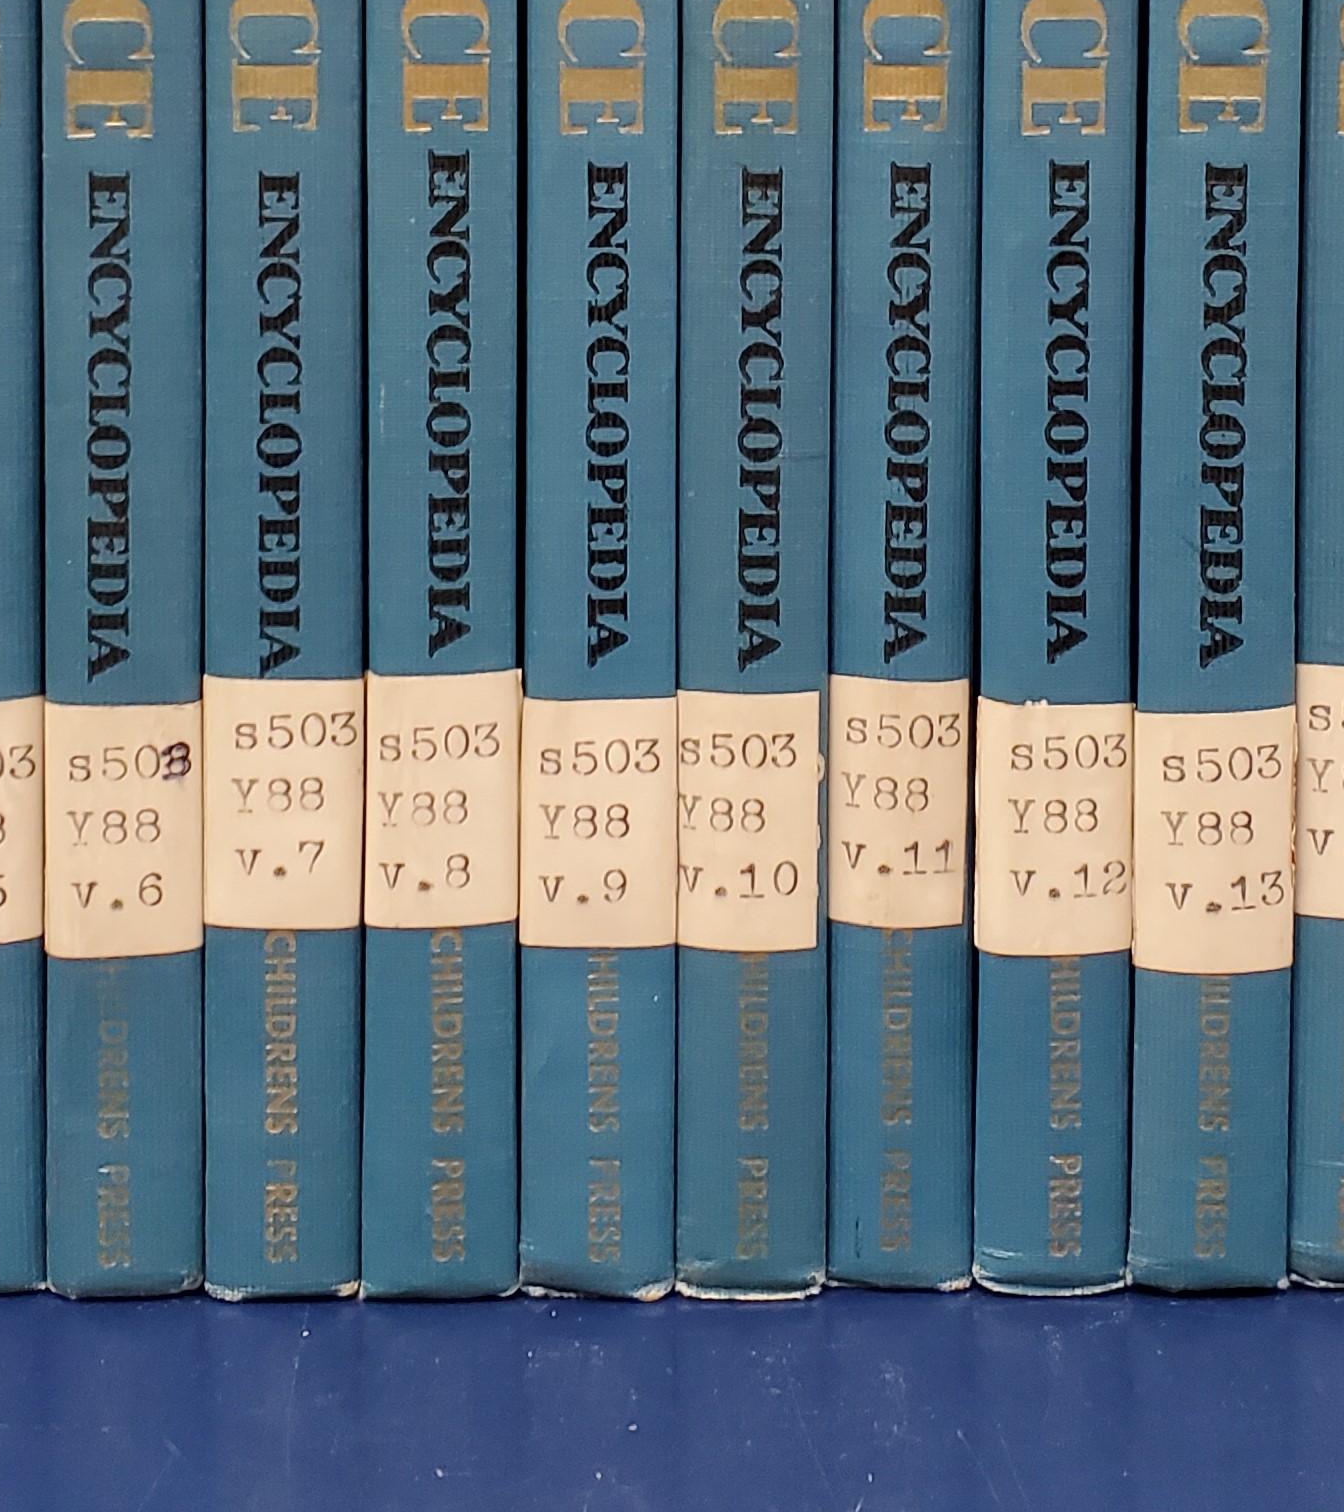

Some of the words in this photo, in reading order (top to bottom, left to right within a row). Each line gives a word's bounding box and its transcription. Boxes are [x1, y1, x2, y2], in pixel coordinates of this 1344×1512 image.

[425, 149, 472, 659] ENCYCLOPEDIA
[737, 166, 785, 673] ENCYCLOPEDIA
[1044, 159, 1091, 665] ENCYCLOPEDIA
[256, 170, 303, 679] ENCYCLOPEDIA
[231, 776, 325, 812] Y88
[377, 789, 469, 828] Y88
[841, 771, 930, 814] Y88
[66, 807, 162, 845] Y88
[540, 803, 631, 840] Y88
[675, 792, 766, 834] Y88
[1007, 797, 1099, 835] Y88
[1161, 810, 1254, 846] Y88
